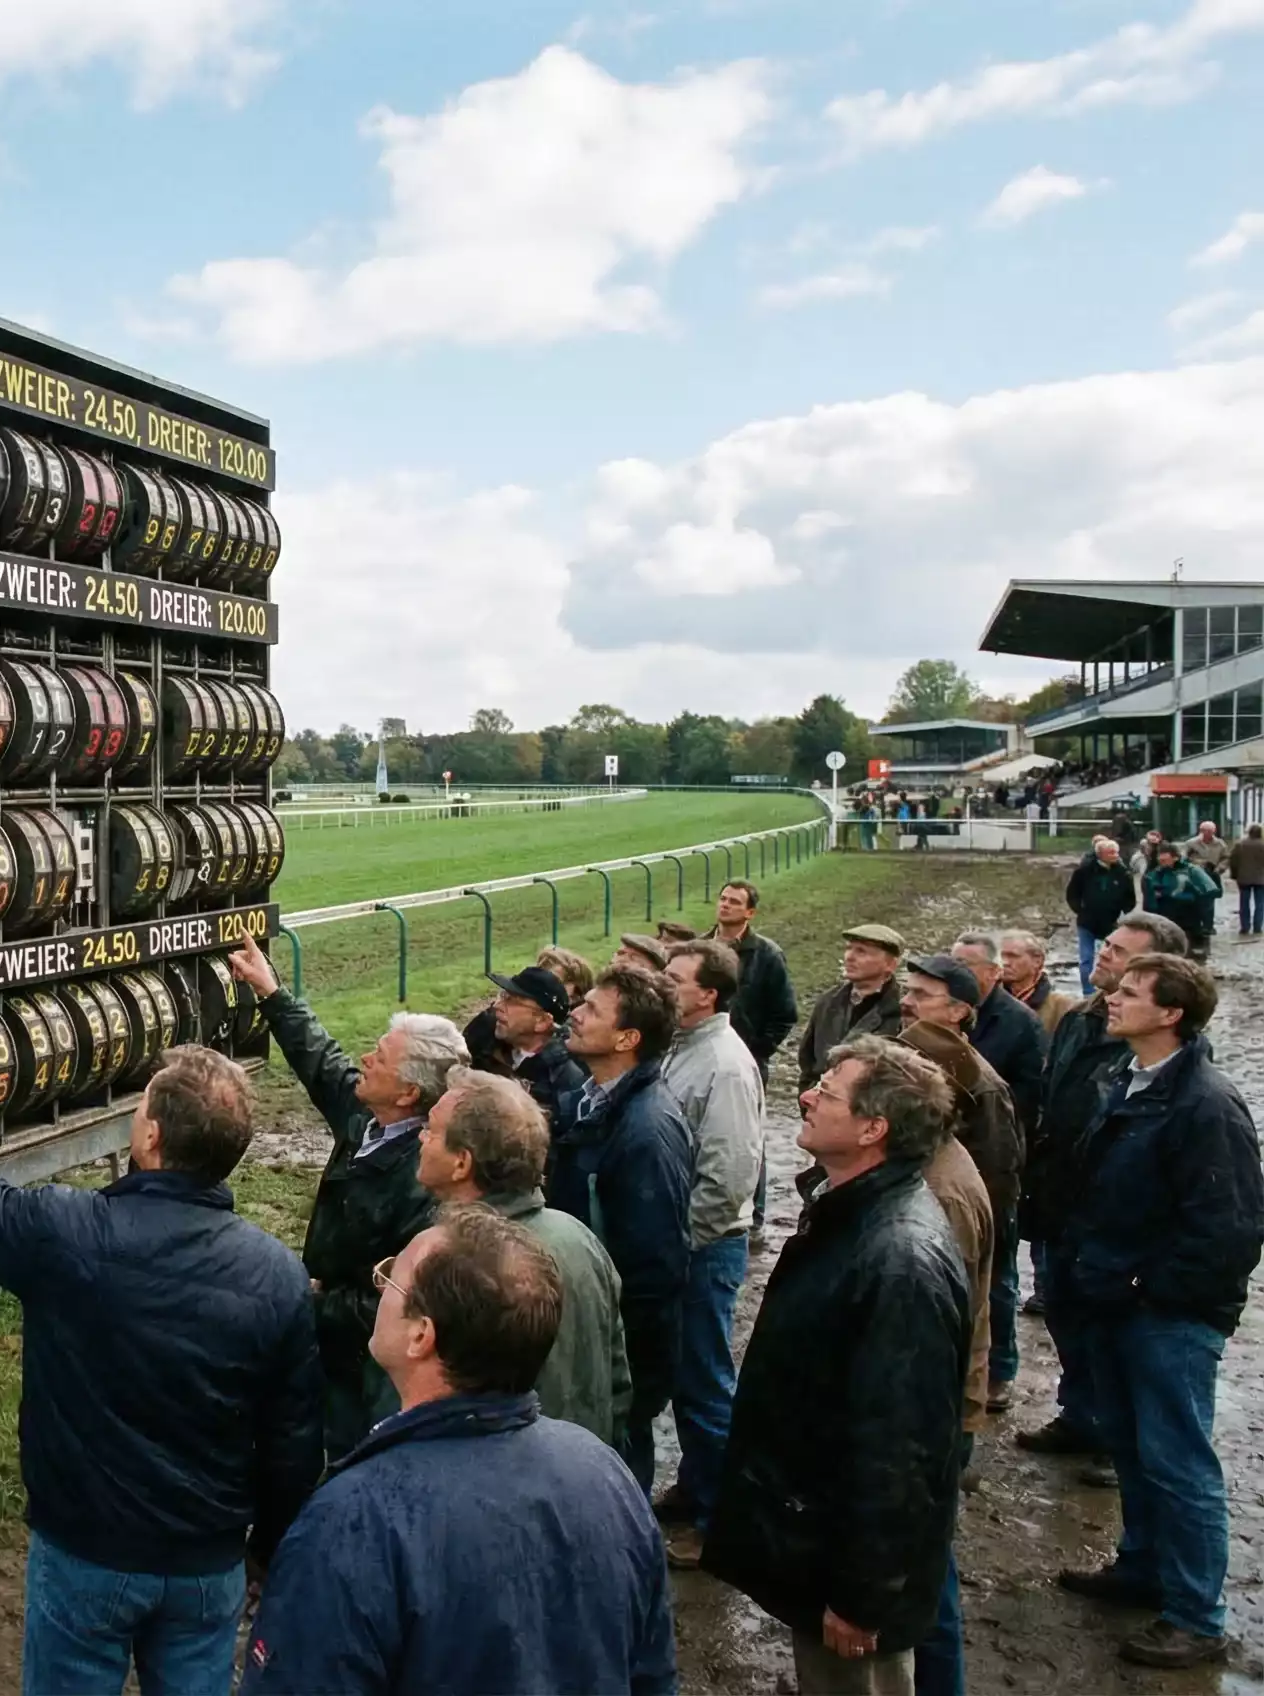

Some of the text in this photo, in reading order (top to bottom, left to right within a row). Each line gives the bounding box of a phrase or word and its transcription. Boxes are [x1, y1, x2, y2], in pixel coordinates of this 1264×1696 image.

[84, 390, 142, 447] 24.50,
[148, 411, 212, 465] DREIER:
[218, 438, 266, 482] 120.00
[85, 575, 143, 623] 24.50,
[150, 587, 212, 628] DREIER:
[218, 599, 266, 636] 120.00
[83, 931, 141, 968] 24.50,
[149, 920, 212, 956] DREIER:
[218, 910, 266, 943] 12000
